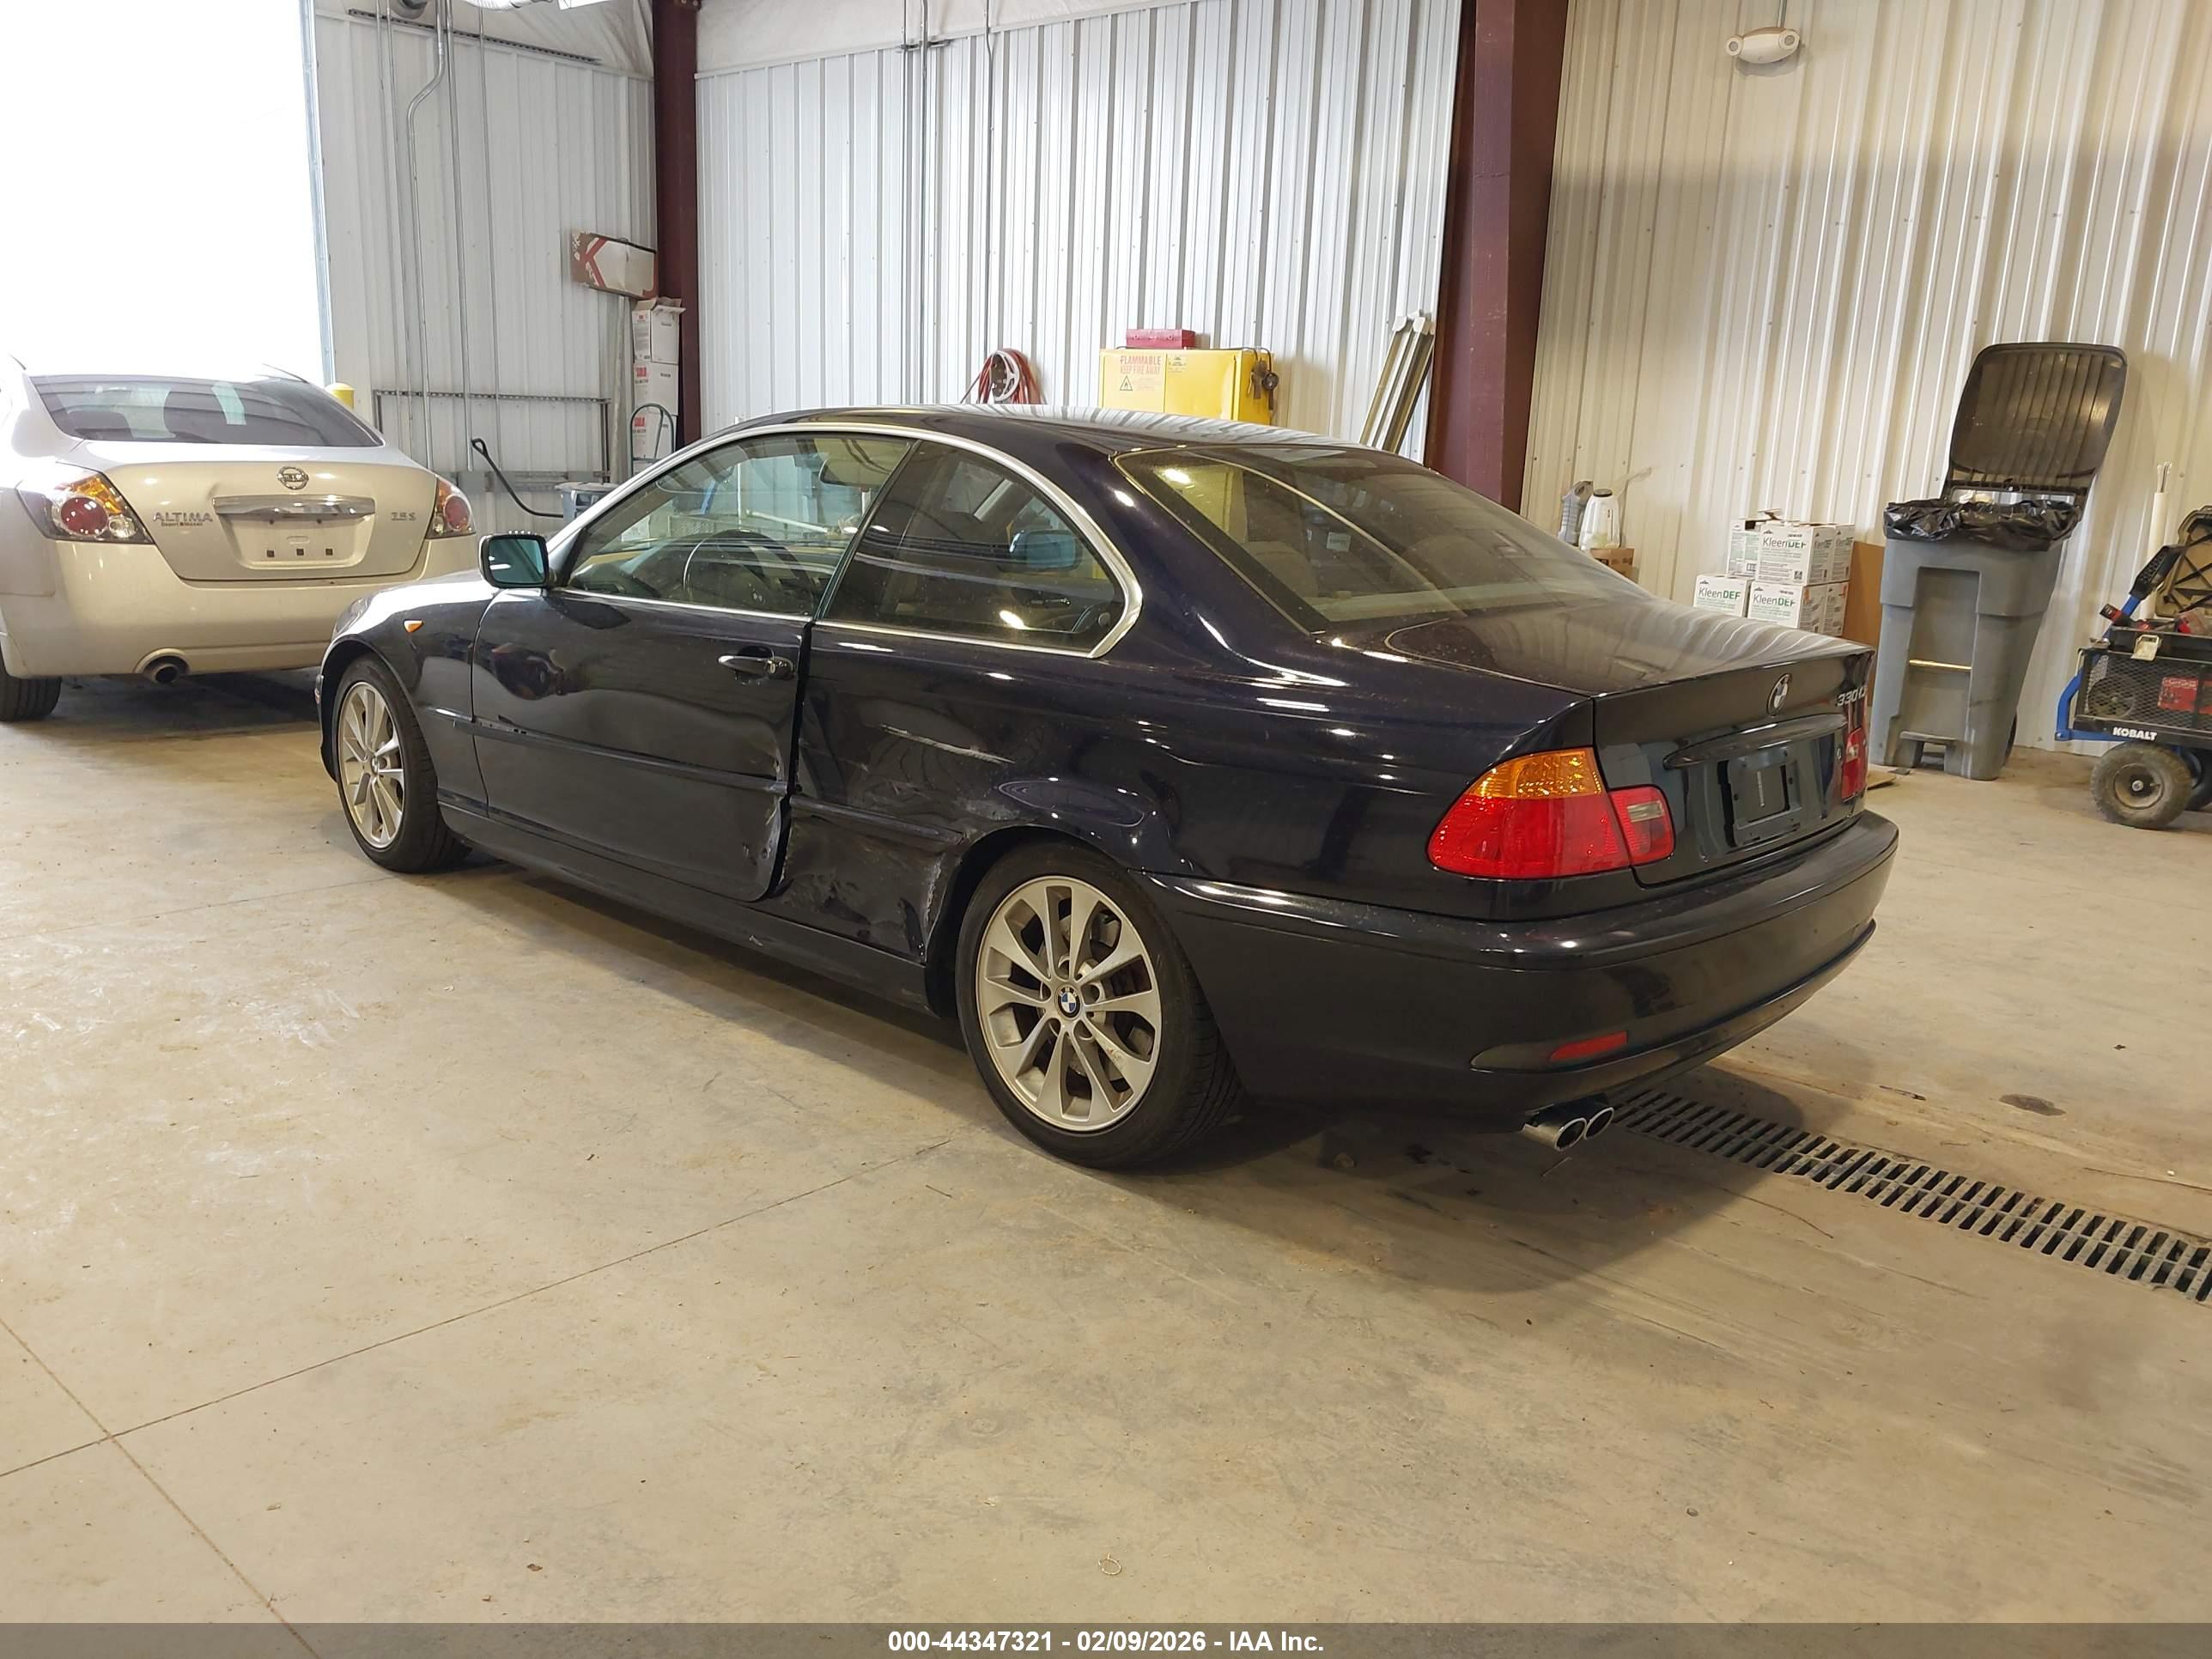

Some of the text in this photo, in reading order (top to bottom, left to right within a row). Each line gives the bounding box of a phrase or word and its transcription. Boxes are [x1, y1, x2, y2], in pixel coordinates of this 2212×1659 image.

[1120, 356, 1162, 366] FLAMMABLE
[1133, 365, 1145, 375] FIRE
[1146, 365, 1161, 375] AWAY
[153, 512, 213, 522] ALTIMA
[1762, 537, 1808, 549] KleenDEF
[1698, 586, 1742, 600] KleenDEF
[1753, 593, 1796, 607] KleenDEF
[2112, 726, 2158, 741] KOBALT
